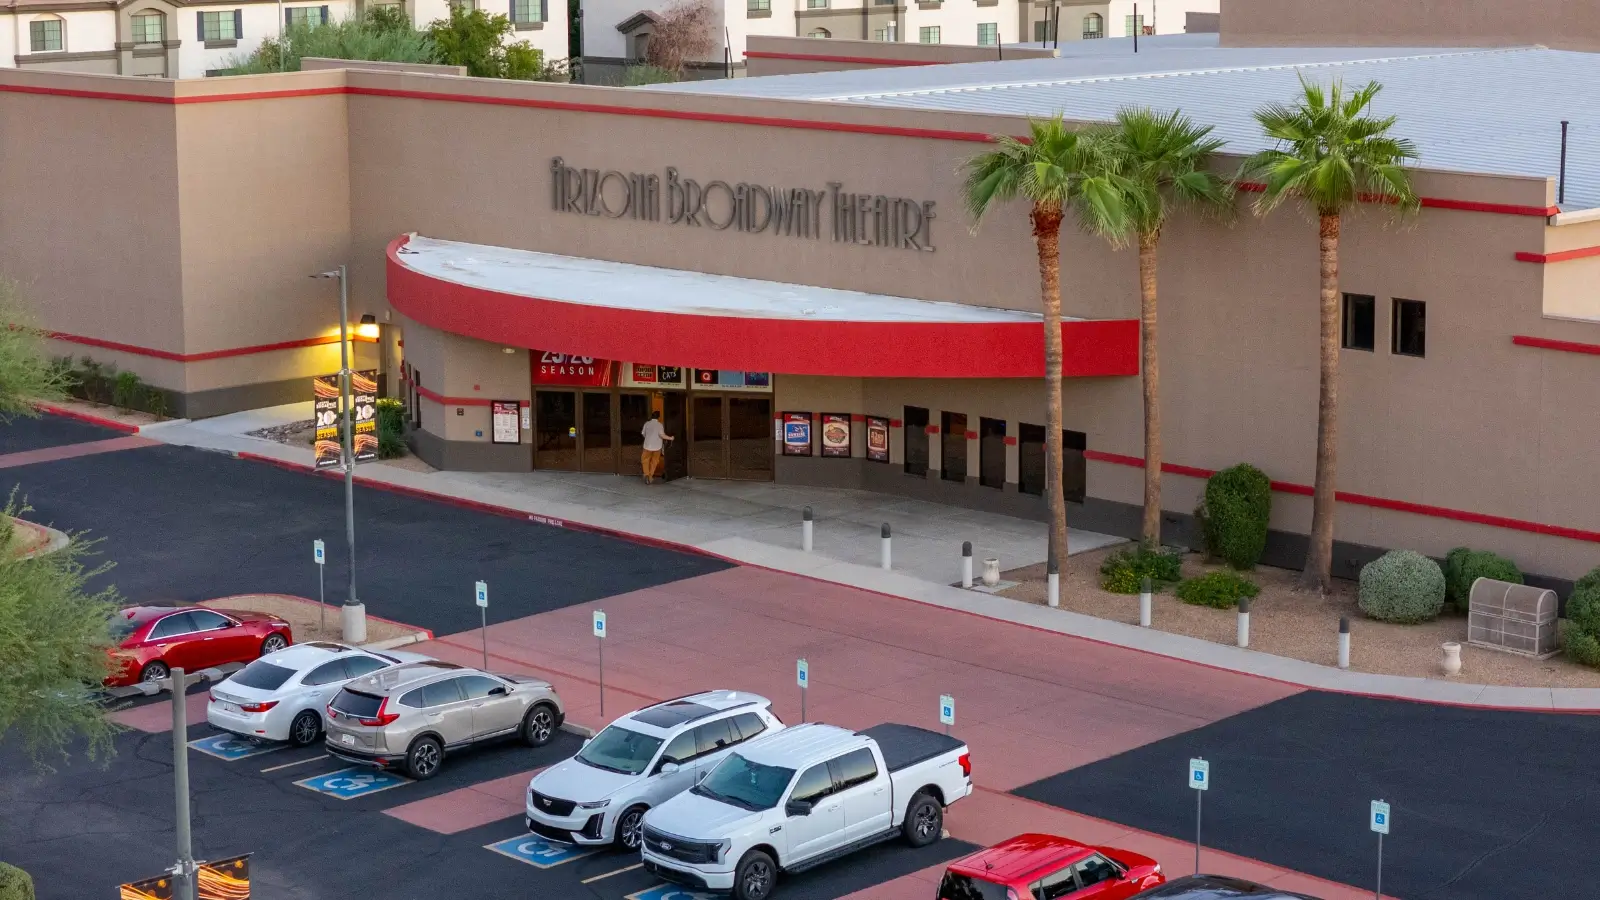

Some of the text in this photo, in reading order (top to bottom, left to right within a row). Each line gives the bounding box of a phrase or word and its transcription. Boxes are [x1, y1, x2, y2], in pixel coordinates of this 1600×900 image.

[549, 155, 937, 252] ARIZONA BROADWAY THEATRE
[541, 365, 594, 376] SEASON
[662, 371, 677, 380] CATS
